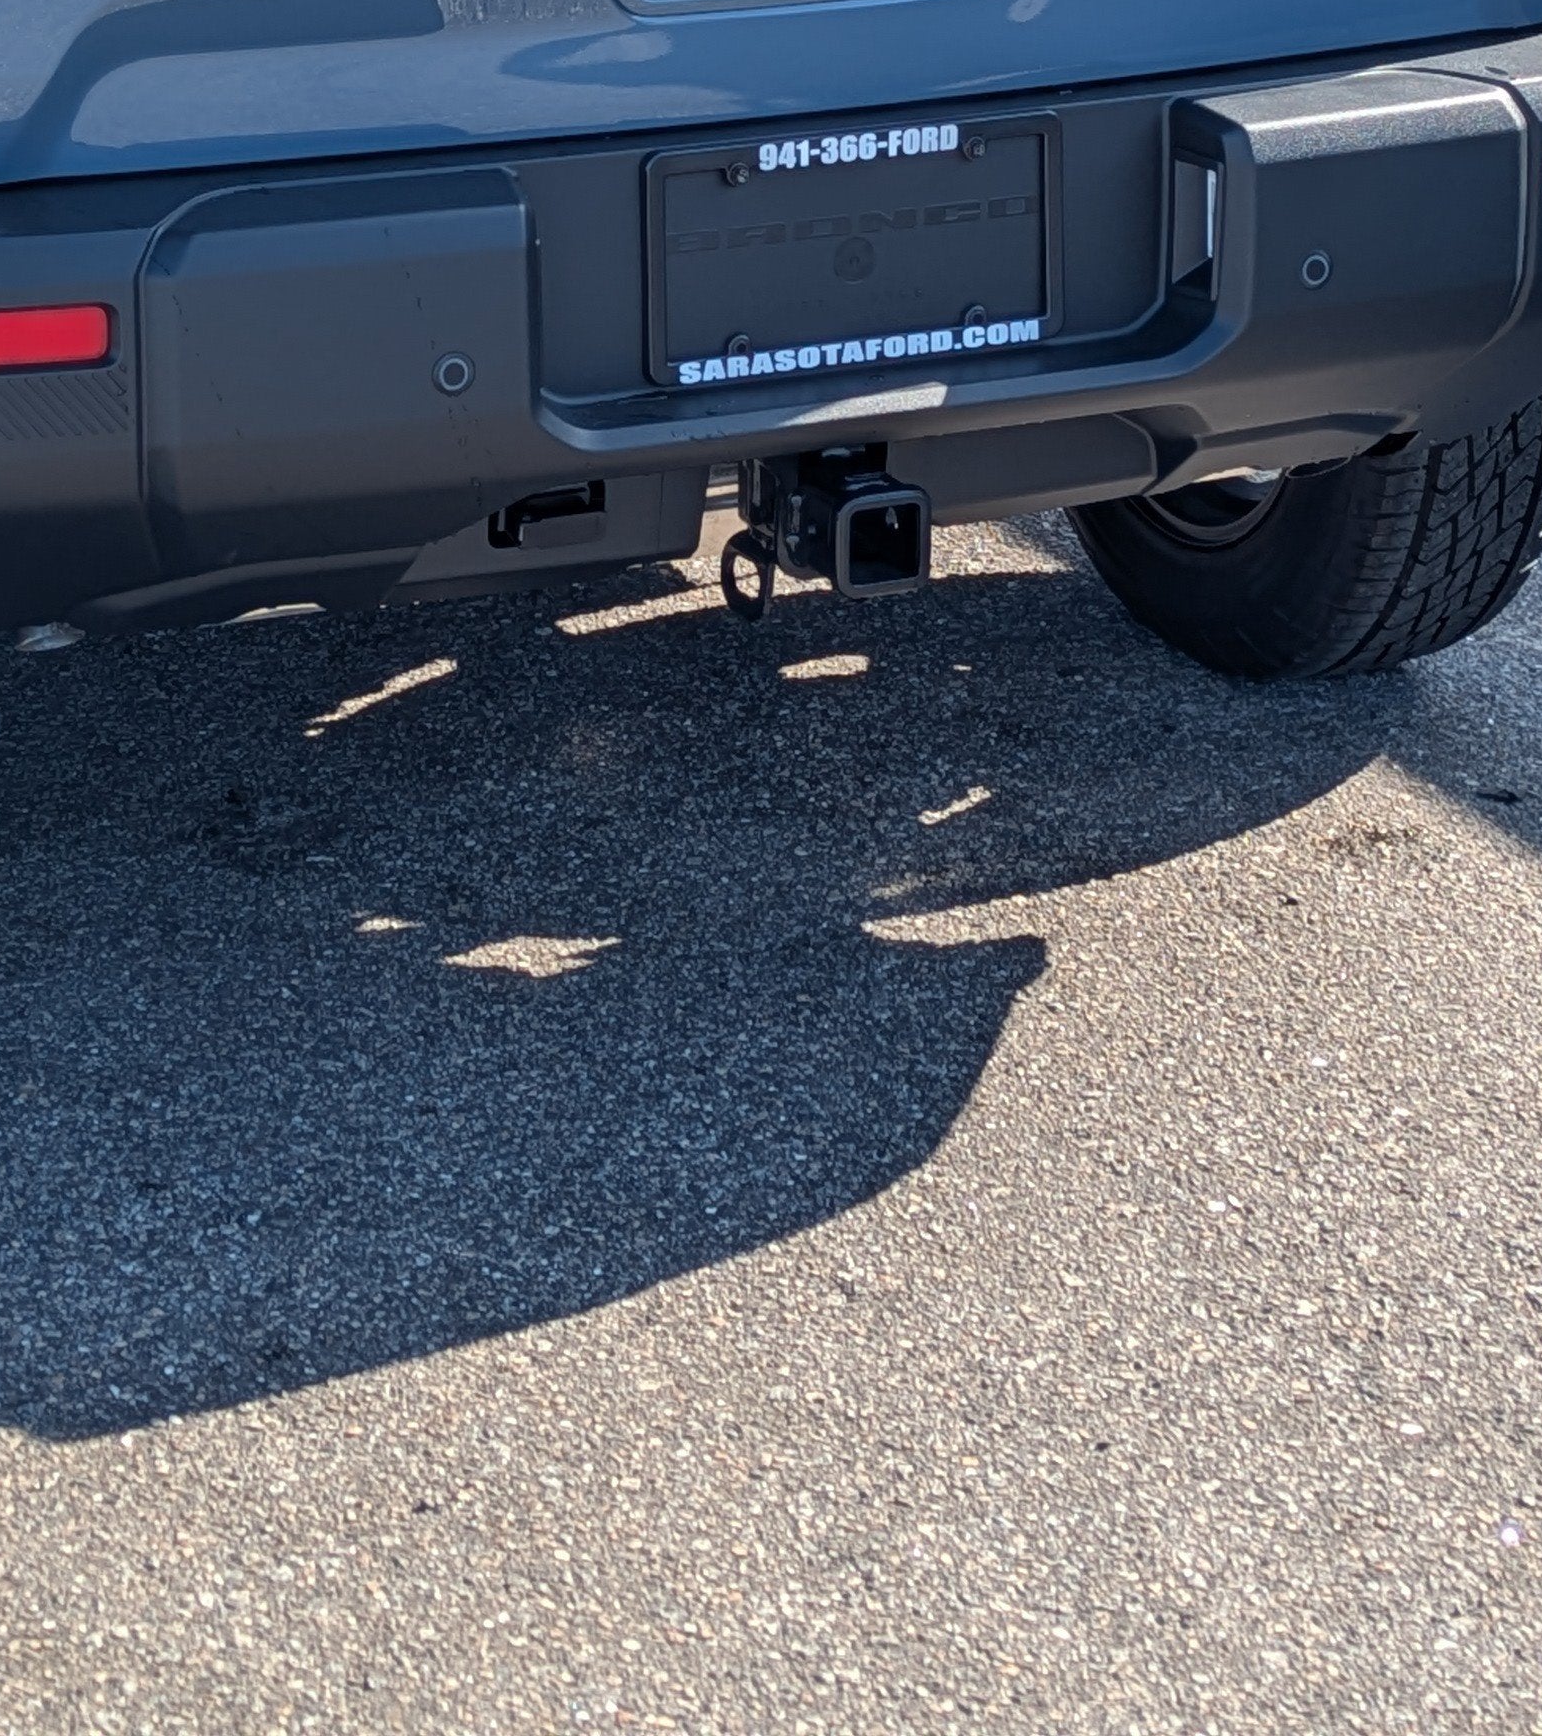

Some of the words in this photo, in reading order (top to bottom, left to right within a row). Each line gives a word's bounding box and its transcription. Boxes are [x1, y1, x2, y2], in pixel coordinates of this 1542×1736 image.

[758, 123, 959, 173] 941-366-FORD
[665, 194, 1039, 254] BRONCO
[678, 319, 1041, 387] SARASOTAFORD.COM
